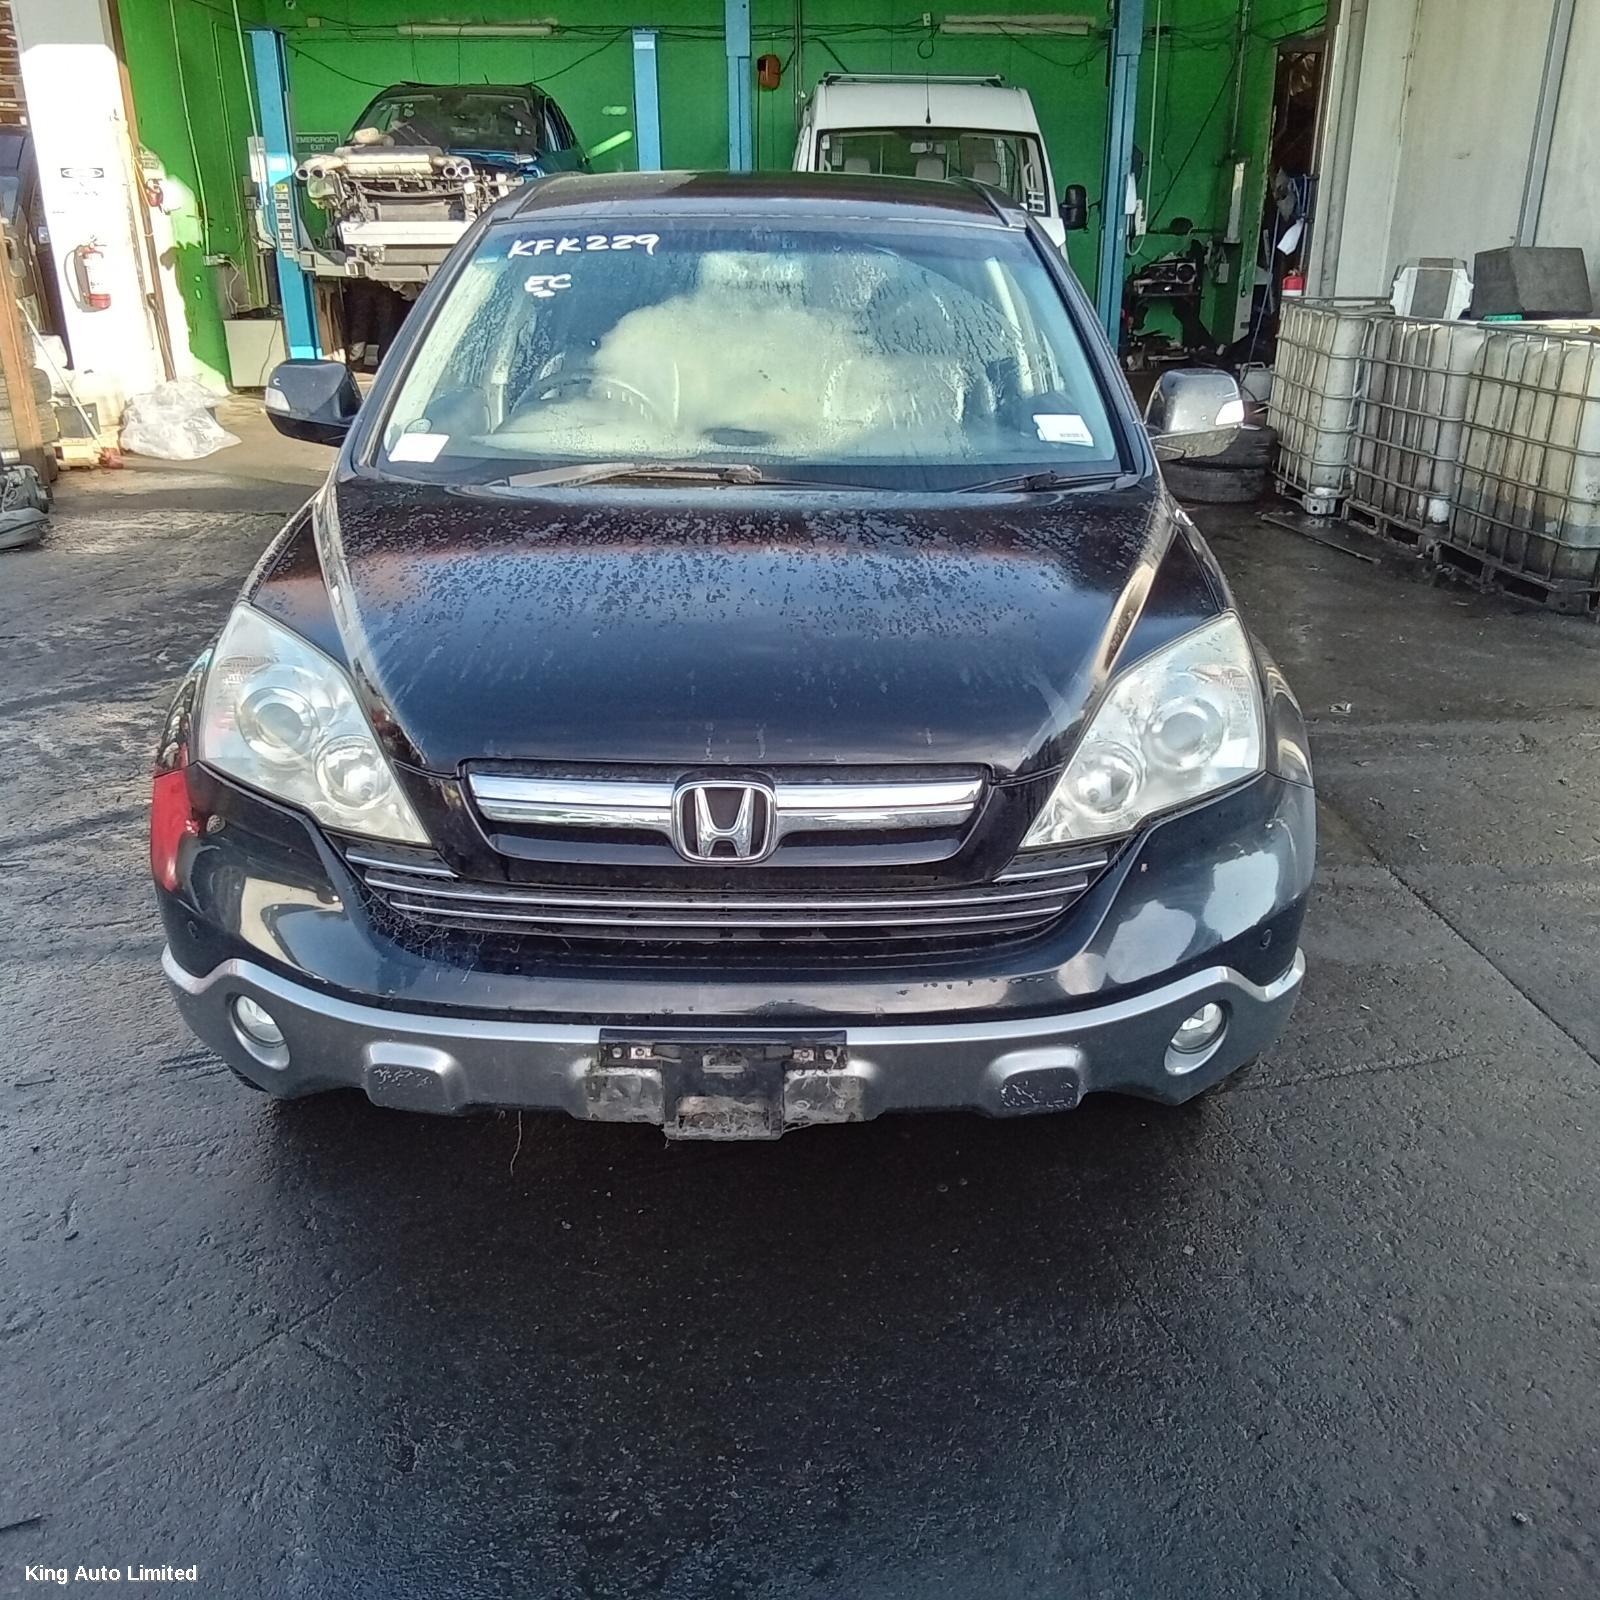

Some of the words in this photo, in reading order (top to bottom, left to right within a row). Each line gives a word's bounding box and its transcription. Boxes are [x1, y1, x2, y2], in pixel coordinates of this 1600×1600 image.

[296, 136, 338, 144] EMERGENCY
[310, 143, 325, 151] EXIT
[507, 233, 660, 259] KFK229
[524, 273, 572, 293] EC
